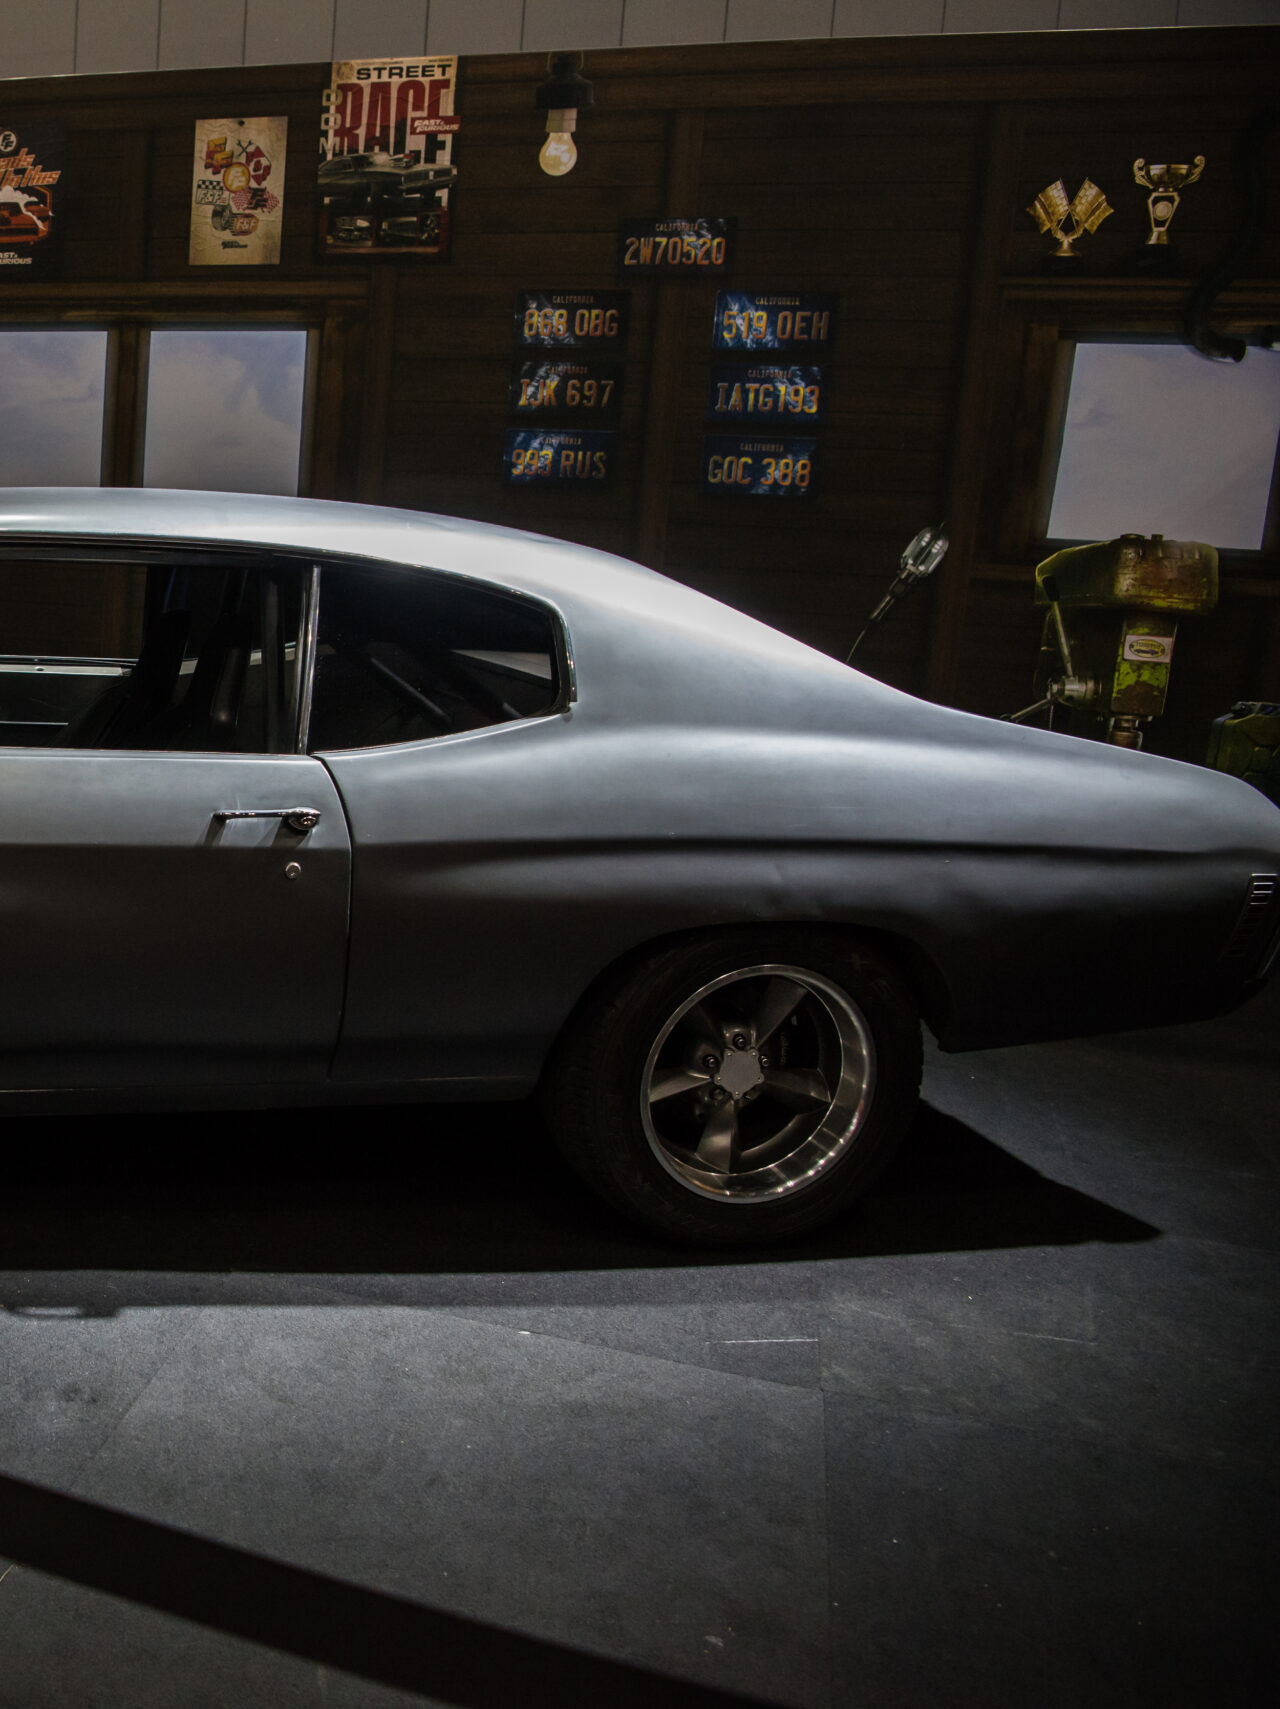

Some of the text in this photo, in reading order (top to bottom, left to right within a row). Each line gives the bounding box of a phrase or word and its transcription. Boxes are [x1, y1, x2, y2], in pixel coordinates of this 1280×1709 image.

[356, 64, 451, 80] STREET
[414, 119, 440, 128] FAST
[415, 124, 460, 133] FURIOUS
[655, 223, 699, 232] CALIFORNIA
[624, 236, 726, 266] 2W70520
[552, 295, 595, 304] CALIFORNIA
[755, 296, 800, 306] CALIFORNIA
[524, 308, 568, 337] 868
[722, 310, 768, 340] 519
[747, 369, 793, 379] CALIFORNIA
[566, 378, 615, 408] 697
[740, 442, 785, 452] CALIFORNIA
[511, 448, 608, 480] 993 RUS
[760, 457, 812, 487] 388
